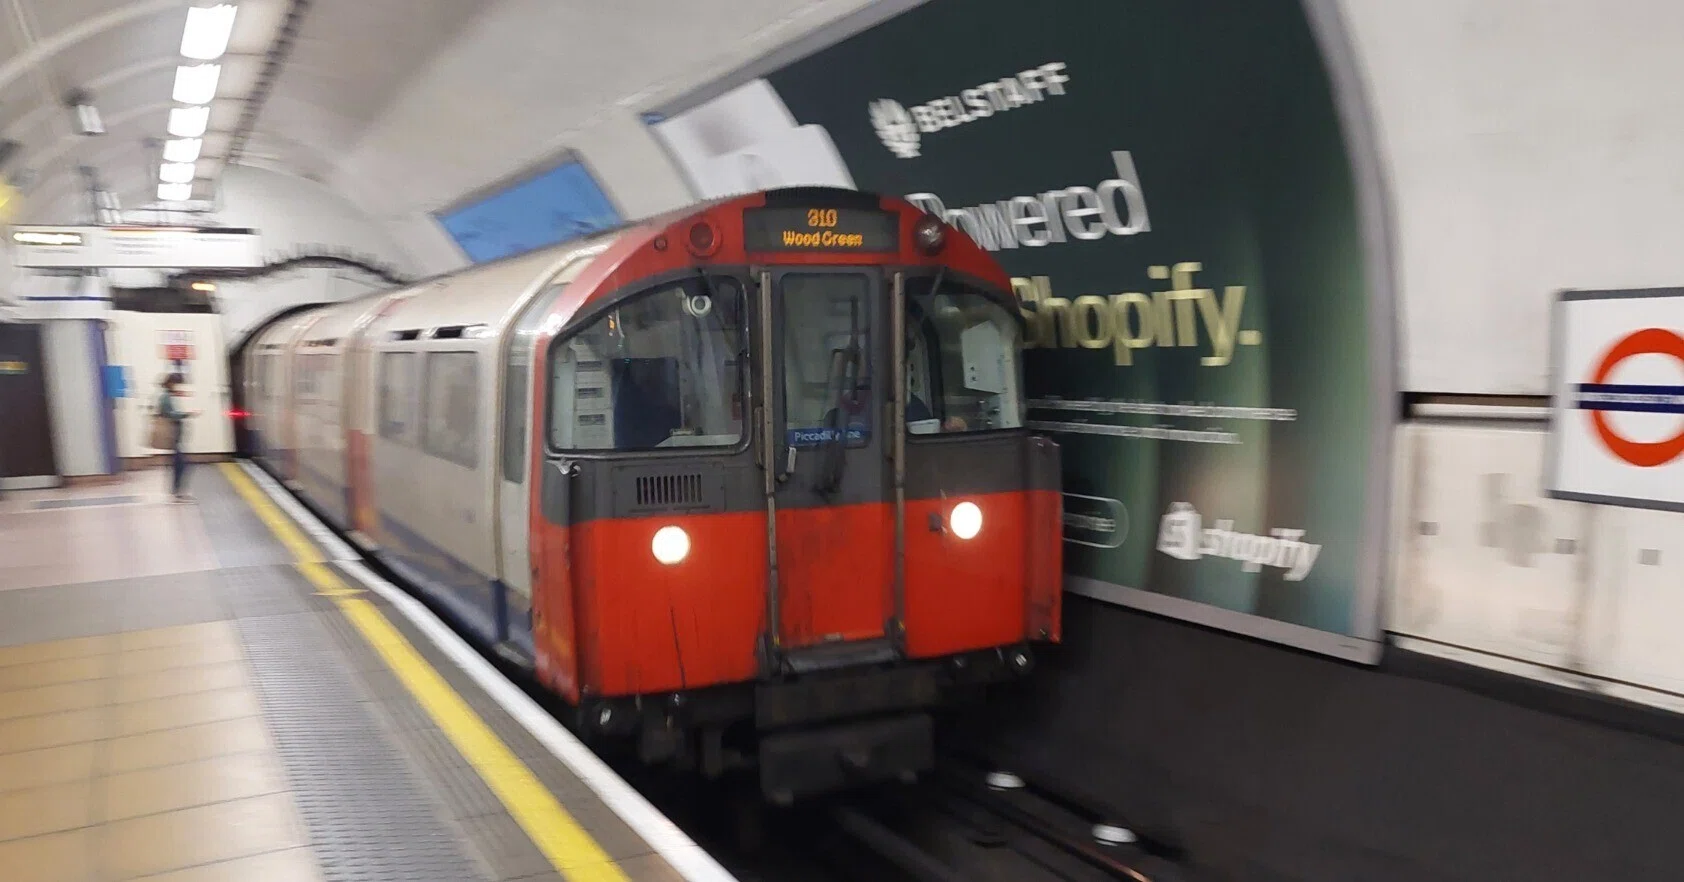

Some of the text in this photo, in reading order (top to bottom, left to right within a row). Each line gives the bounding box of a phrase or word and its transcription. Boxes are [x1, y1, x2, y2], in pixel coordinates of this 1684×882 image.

[908, 62, 1070, 133] BELSTAFF
[807, 208, 837, 227] 310
[783, 230, 863, 247] Wood Green
[1197, 518, 1323, 582] shopify
